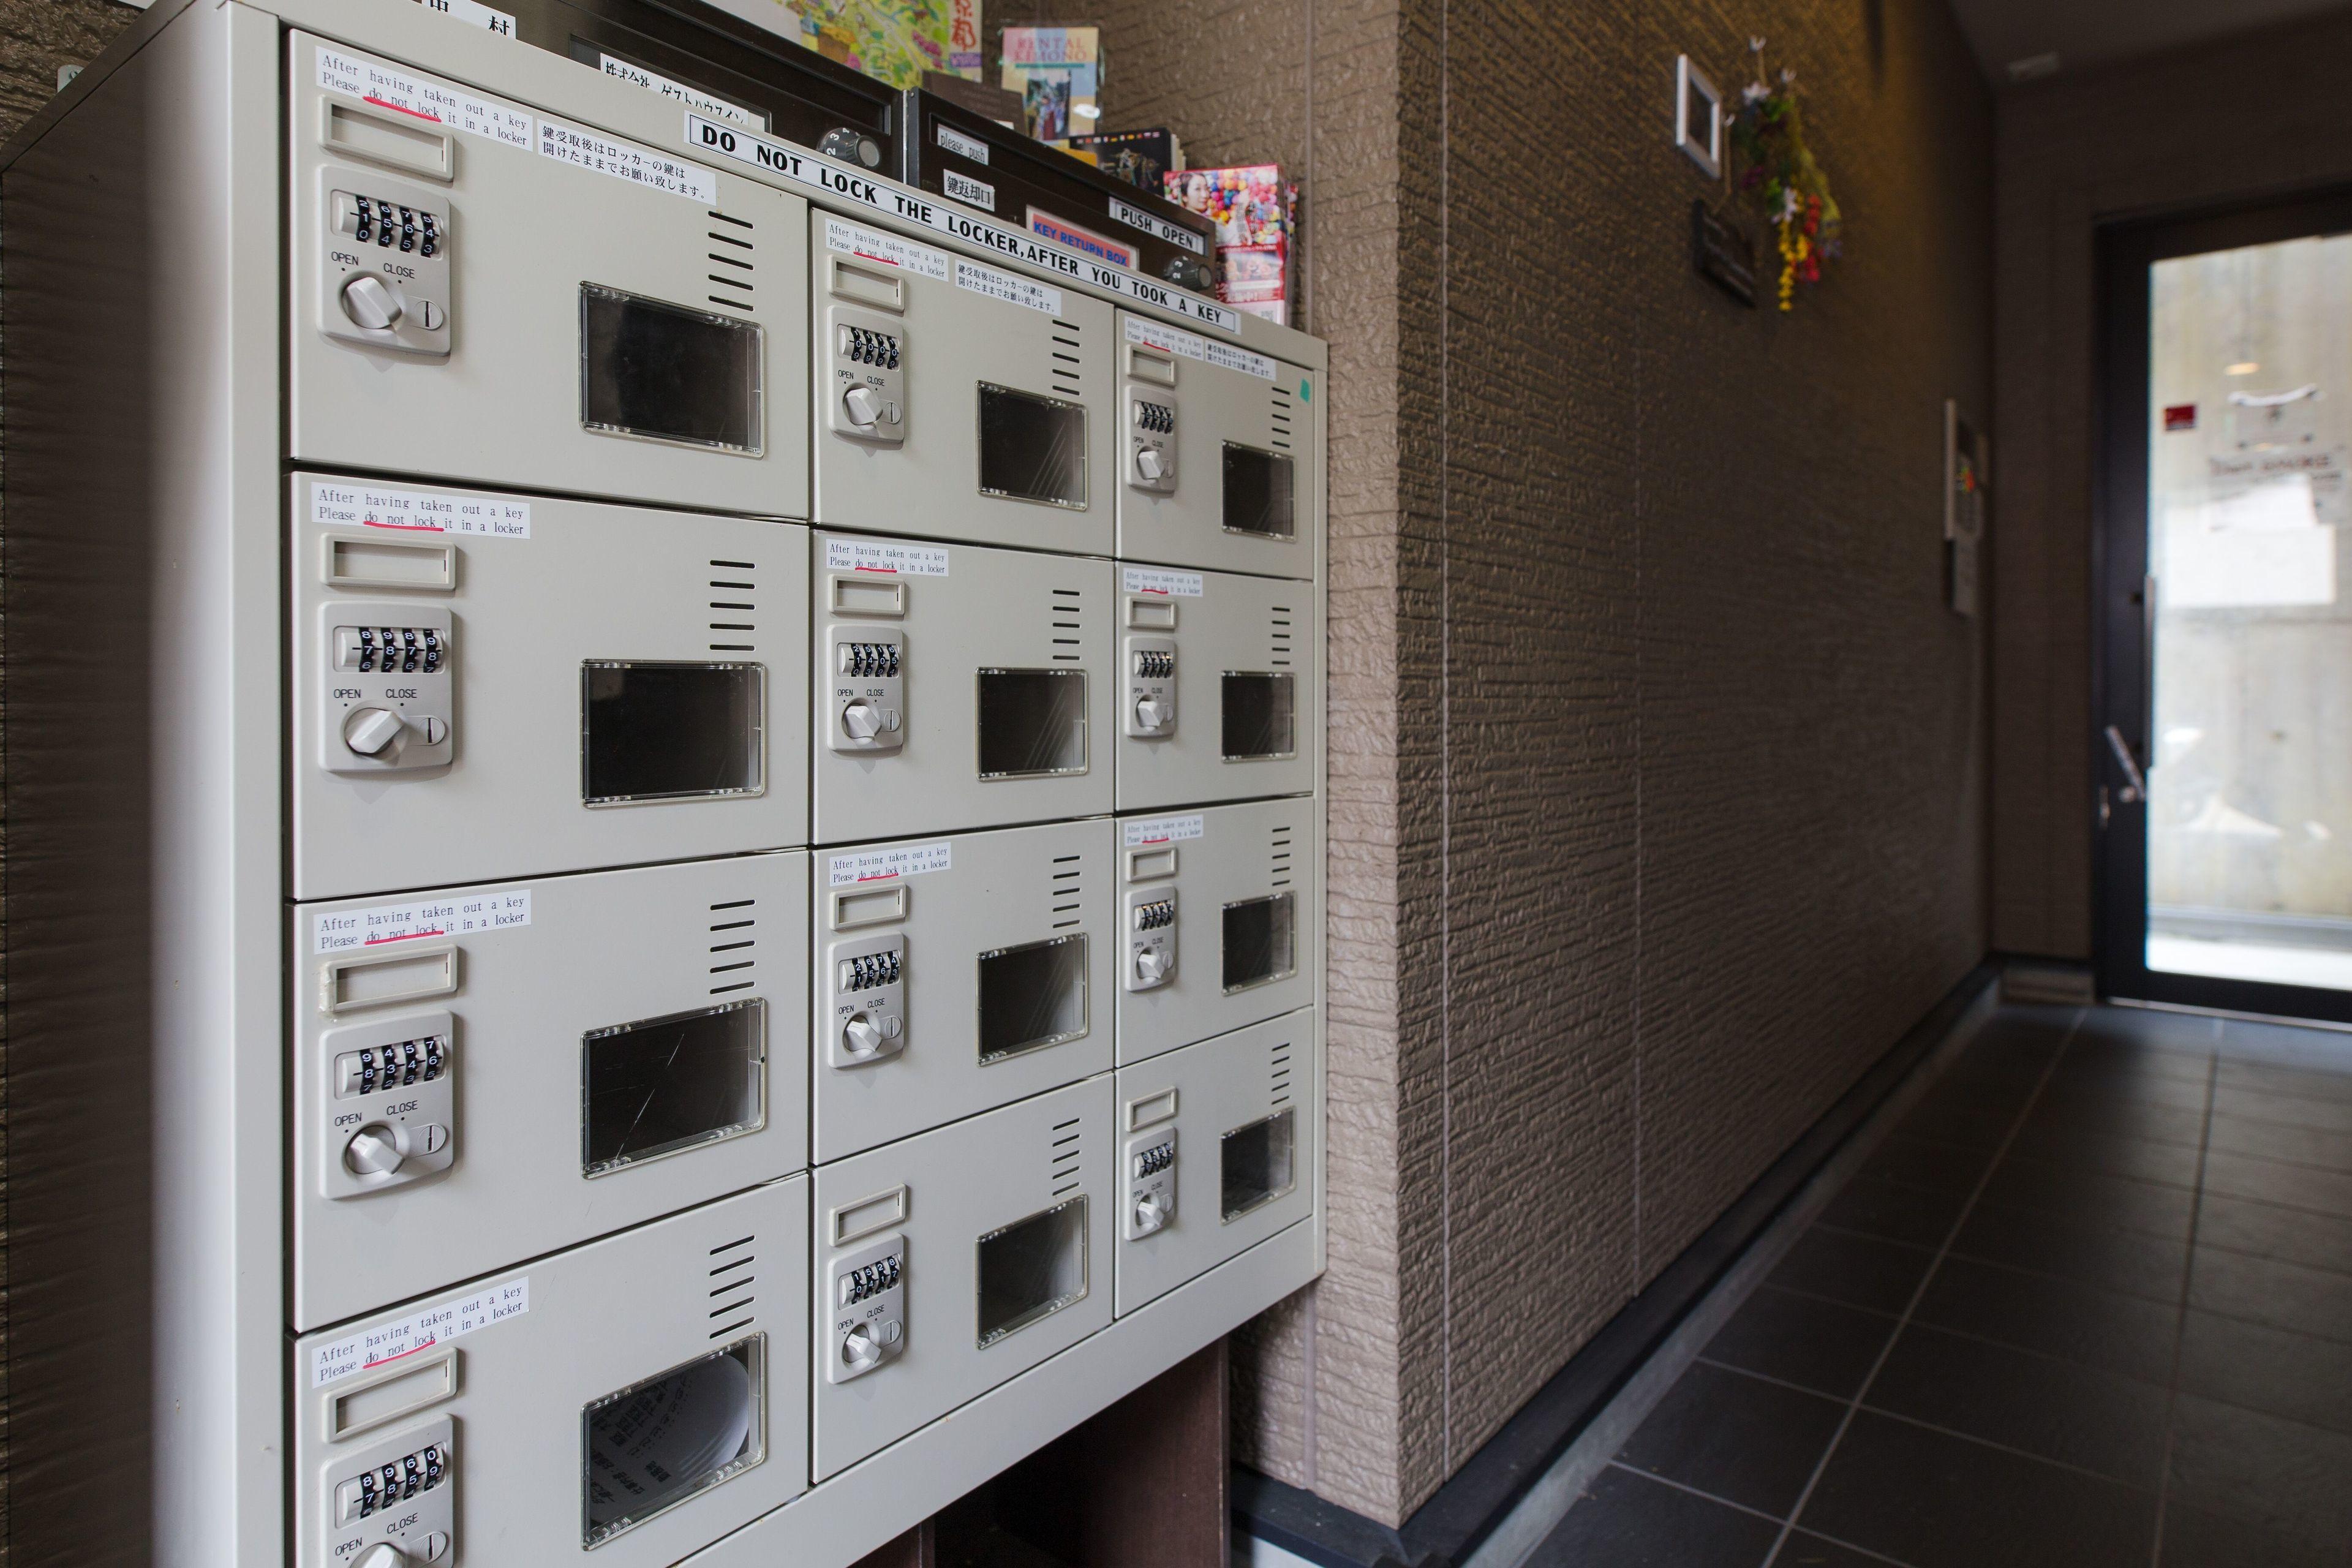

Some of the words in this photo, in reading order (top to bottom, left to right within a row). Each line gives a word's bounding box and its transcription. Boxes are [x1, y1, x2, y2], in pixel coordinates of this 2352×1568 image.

[1017, 37, 1082, 49] RENTAL
[322, 55, 358, 77] After
[369, 69, 413, 96] having
[424, 88, 456, 107] taken
[466, 103, 483, 116] out
[493, 112, 499, 121] a
[508, 114, 526, 131] key
[323, 72, 360, 94] Please
[369, 87, 382, 100] do
[391, 96, 408, 109] not
[418, 101, 439, 118] lock
[448, 111, 456, 124] it
[465, 117, 475, 130] in
[483, 125, 489, 134] a
[497, 127, 526, 146] locker
[829, 132, 840, 141] 3
[543, 125, 685, 179] 鍵受取後はロッカーの鍵は
[826, 147, 836, 156] 2
[941, 133, 963, 153] please
[968, 147, 986, 163] push
[543, 141, 704, 200] 開けたままでお願い致します。
[948, 176, 990, 205] 鍵返却口
[703, 124, 736, 153] DO
[756, 145, 802, 176] NOT
[821, 167, 878, 205] LOCK
[894, 195, 932, 224] THE
[1091, 266, 1121, 289] YOU
[1131, 281, 1168, 306] TOOK
[1178, 299, 1188, 313] A
[1197, 306, 1222, 324] KEY
[1121, 207, 1152, 232] PUSH
[1163, 227, 1194, 249] OPEN
[829, 224, 849, 238] After
[854, 232, 880, 248] having
[886, 241, 903, 254] taken
[908, 250, 919, 258] out
[933, 255, 944, 267] key
[1033, 221, 1057, 239] KEY
[1060, 232, 1104, 258] RETURN
[1106, 249, 1128, 266] BOX
[331, 251, 359, 266] OPEN
[829, 236, 850, 251] Please
[854, 244, 862, 254] do
[867, 250, 876, 258] not
[882, 252, 894, 263] lock
[899, 257, 903, 266] it
[908, 260, 914, 269] in
[927, 265, 944, 277] locker
[383, 263, 415, 279] CLOSE
[838, 369, 854, 380] OPEN
[867, 375, 885, 386] CLOSE
[318, 489, 354, 503] After
[365, 493, 410, 510] having
[420, 499, 452, 512] taken
[462, 504, 480, 514] out
[505, 507, 523, 520] key
[318, 507, 355, 521] Please
[365, 511, 378, 522] do
[386, 514, 404, 524] not
[414, 514, 435, 527] lock
[444, 518, 452, 529] it
[462, 519, 472, 530] in
[480, 523, 486, 532] a
[494, 522, 523, 535] locker
[829, 544, 850, 554] After
[855, 546, 880, 557] having
[886, 549, 904, 558] taken
[933, 552, 944, 562] key
[830, 557, 850, 567] Please
[855, 559, 862, 567] do
[883, 560, 895, 570] lock
[927, 564, 944, 573] locker
[333, 688, 361, 698] OPEN
[385, 688, 418, 698] CLOSE
[833, 861, 853, 870] After
[859, 857, 883, 866] having
[889, 853, 907, 862] taken
[912, 851, 922, 859] out
[937, 848, 947, 856] key
[833, 873, 853, 883] Please
[858, 870, 865, 879] do
[870, 869, 880, 877] not
[885, 865, 897, 875] lock
[930, 859, 947, 869] locker
[320, 919, 356, 932] After
[367, 912, 412, 925] having
[422, 906, 454, 919] taken
[463, 902, 481, 913] out
[506, 897, 524, 908] key
[321, 937, 357, 949] Please
[367, 931, 380, 943] do
[388, 928, 406, 940] not
[416, 923, 437, 937] lock
[446, 922, 453, 932] it
[463, 919, 473, 930] in
[496, 913, 524, 925] locker
[838, 1005, 854, 1014] OPEN
[867, 998, 885, 1009] CLOSE
[386, 1100, 418, 1116] CLOSE
[334, 1112, 363, 1127] OPEN
[867, 1304, 884, 1318] CLOSE
[320, 1344, 355, 1364] After
[366, 1325, 410, 1348] having
[420, 1311, 452, 1329] taken
[462, 1300, 479, 1315] out
[489, 1297, 494, 1305] a
[503, 1287, 522, 1300] key
[838, 1317, 854, 1330] OPEN
[320, 1361, 356, 1382] Please
[365, 1352, 378, 1366] do
[387, 1343, 404, 1358] not
[414, 1331, 435, 1348] lock
[444, 1325, 452, 1338] it
[462, 1321, 471, 1332] in
[480, 1316, 485, 1325] a
[493, 1303, 522, 1321] locker
[386, 1512, 418, 1534] CLOSE
[335, 1537, 363, 1556] OPEN
